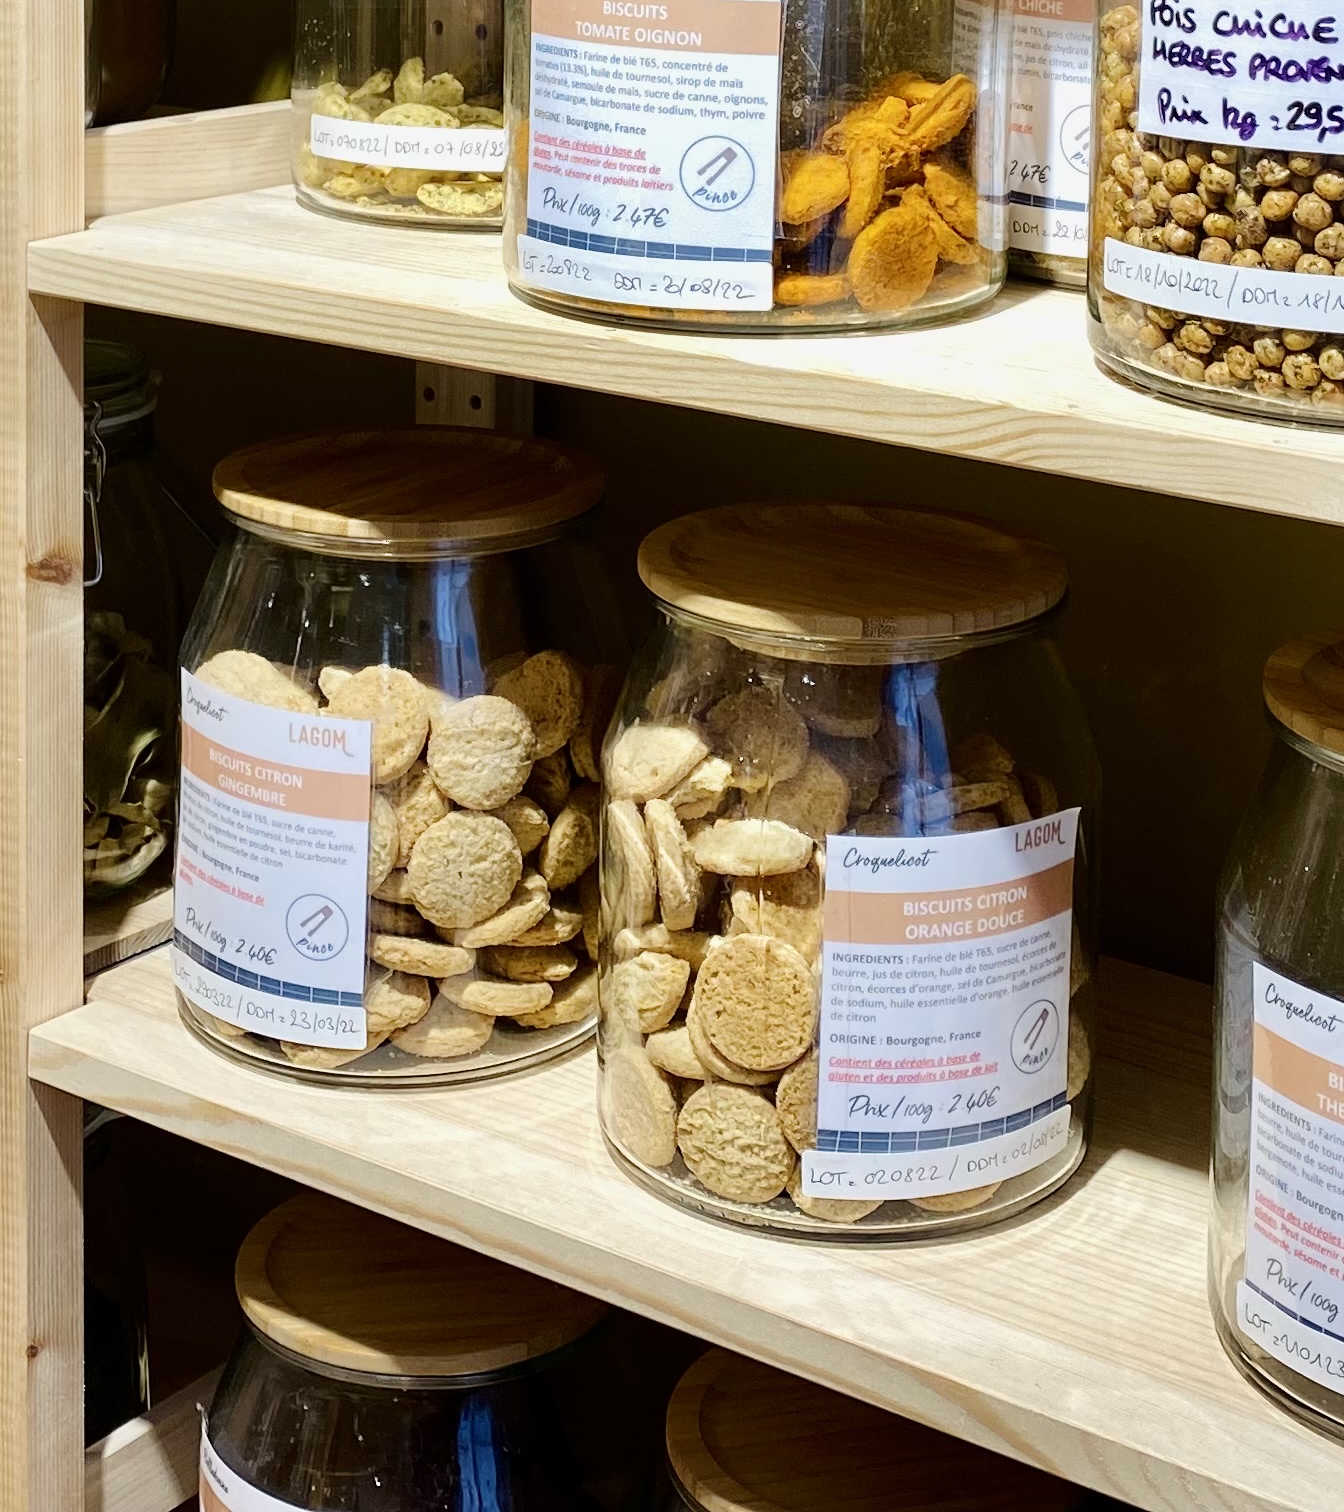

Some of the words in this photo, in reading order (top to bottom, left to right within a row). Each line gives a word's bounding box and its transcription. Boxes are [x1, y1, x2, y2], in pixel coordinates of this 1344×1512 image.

[603, 0, 668, 20] BISCUITS
[576, 20, 630, 41] TOMATE
[634, 27, 702, 46] OIGNON
[584, 51, 608, 64] Farine
[610, 53, 621, 65] de
[623, 54, 637, 66] blé
[639, 56, 660, 70] T65,
[662, 58, 712, 72] concentré
[715, 62, 728, 73] de
[1153, 36, 1237, 77] HERBES
[1157, 87, 1208, 124] Prix
[612, 204, 669, 228] 2.47€
[289, 723, 355, 757] LAGOM
[209, 748, 251, 776] BISCUITS
[255, 767, 303, 788] CITRON
[218, 774, 286, 806] GINGEMBRE
[844, 847, 938, 873] Croquelicot
[1015, 820, 1066, 852] LAGOM
[904, 898, 973, 916] BISCUITS
[976, 886, 1028, 909] CITRON
[905, 920, 973, 939] ORANGE
[978, 910, 1024, 932] DOUCE
[1265, 983, 1344, 1032] Croquelicot
[830, 1033, 876, 1045] ORIGINE
[886, 1034, 946, 1047] Bourgogne,
[950, 1030, 981, 1041] France
[948, 1086, 1000, 1113] 2.40€
